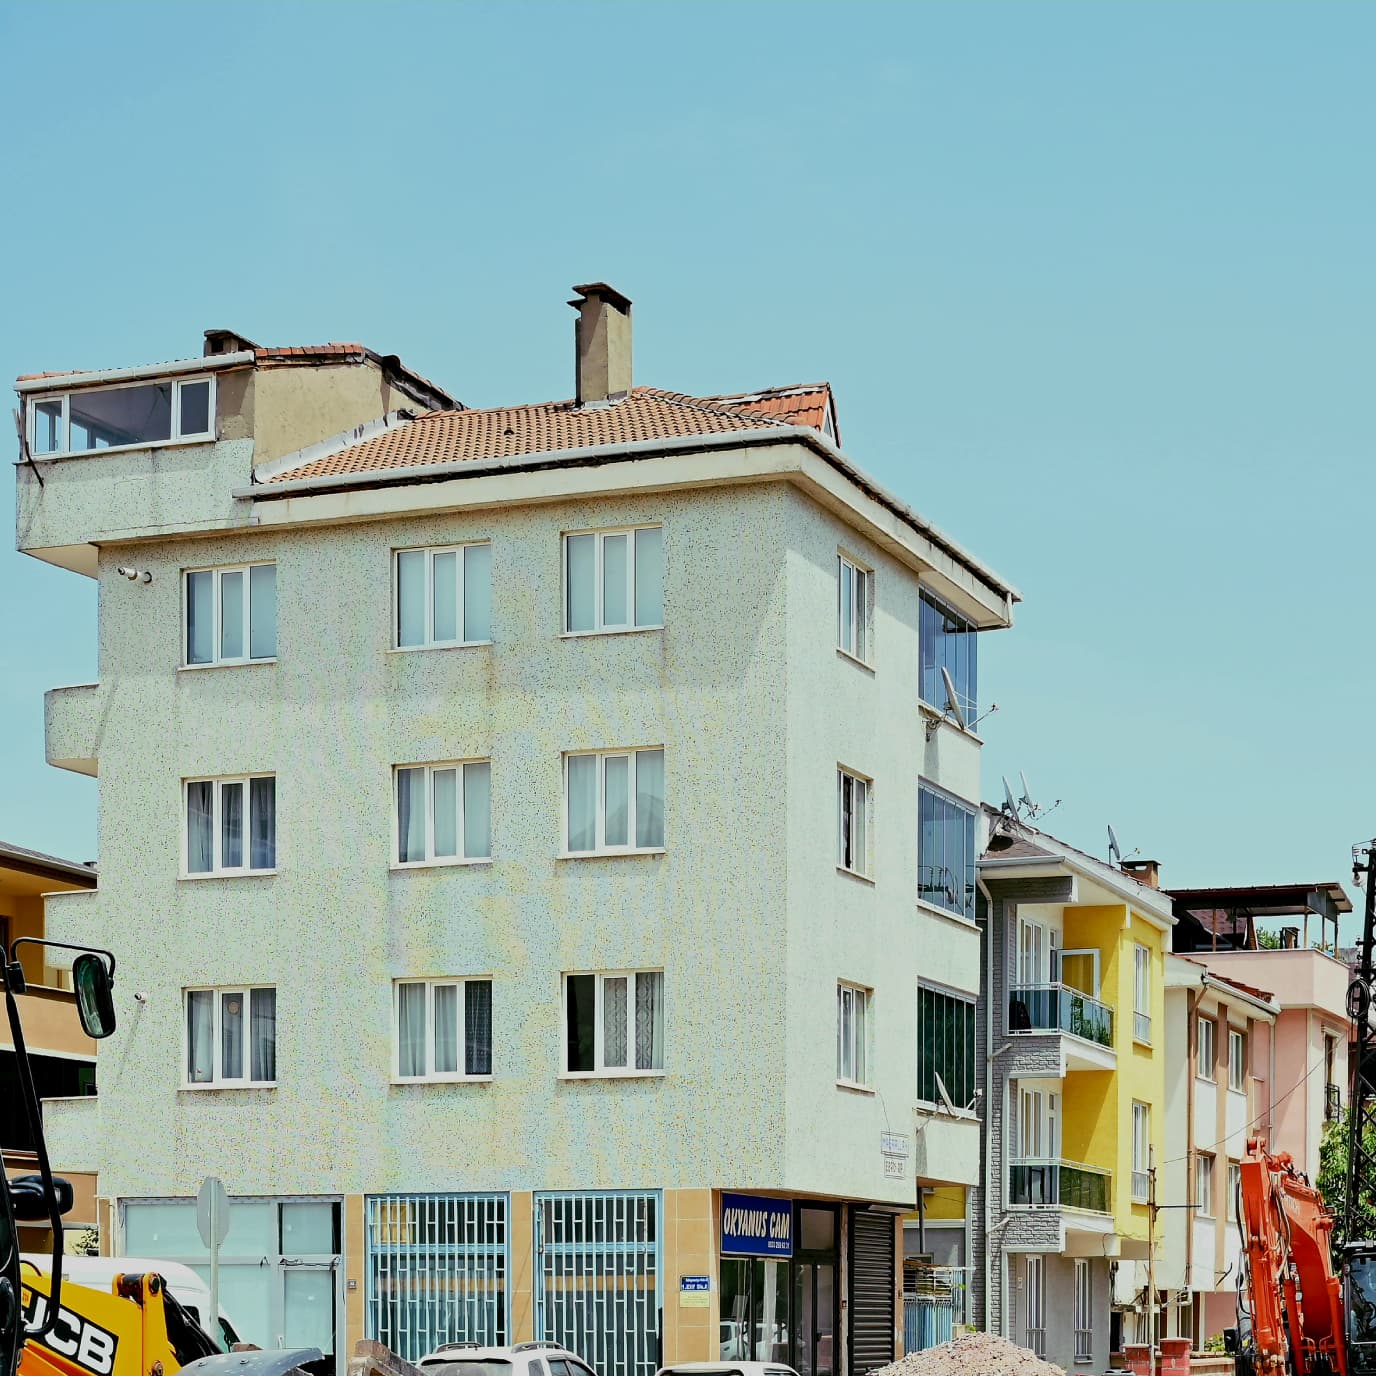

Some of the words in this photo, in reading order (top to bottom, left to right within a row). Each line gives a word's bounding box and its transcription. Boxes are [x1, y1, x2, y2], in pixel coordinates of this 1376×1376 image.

[724, 1208, 768, 1237] OKYANUS
[770, 1212, 790, 1240] CAM
[21, 1296, 114, 1375] JCB
